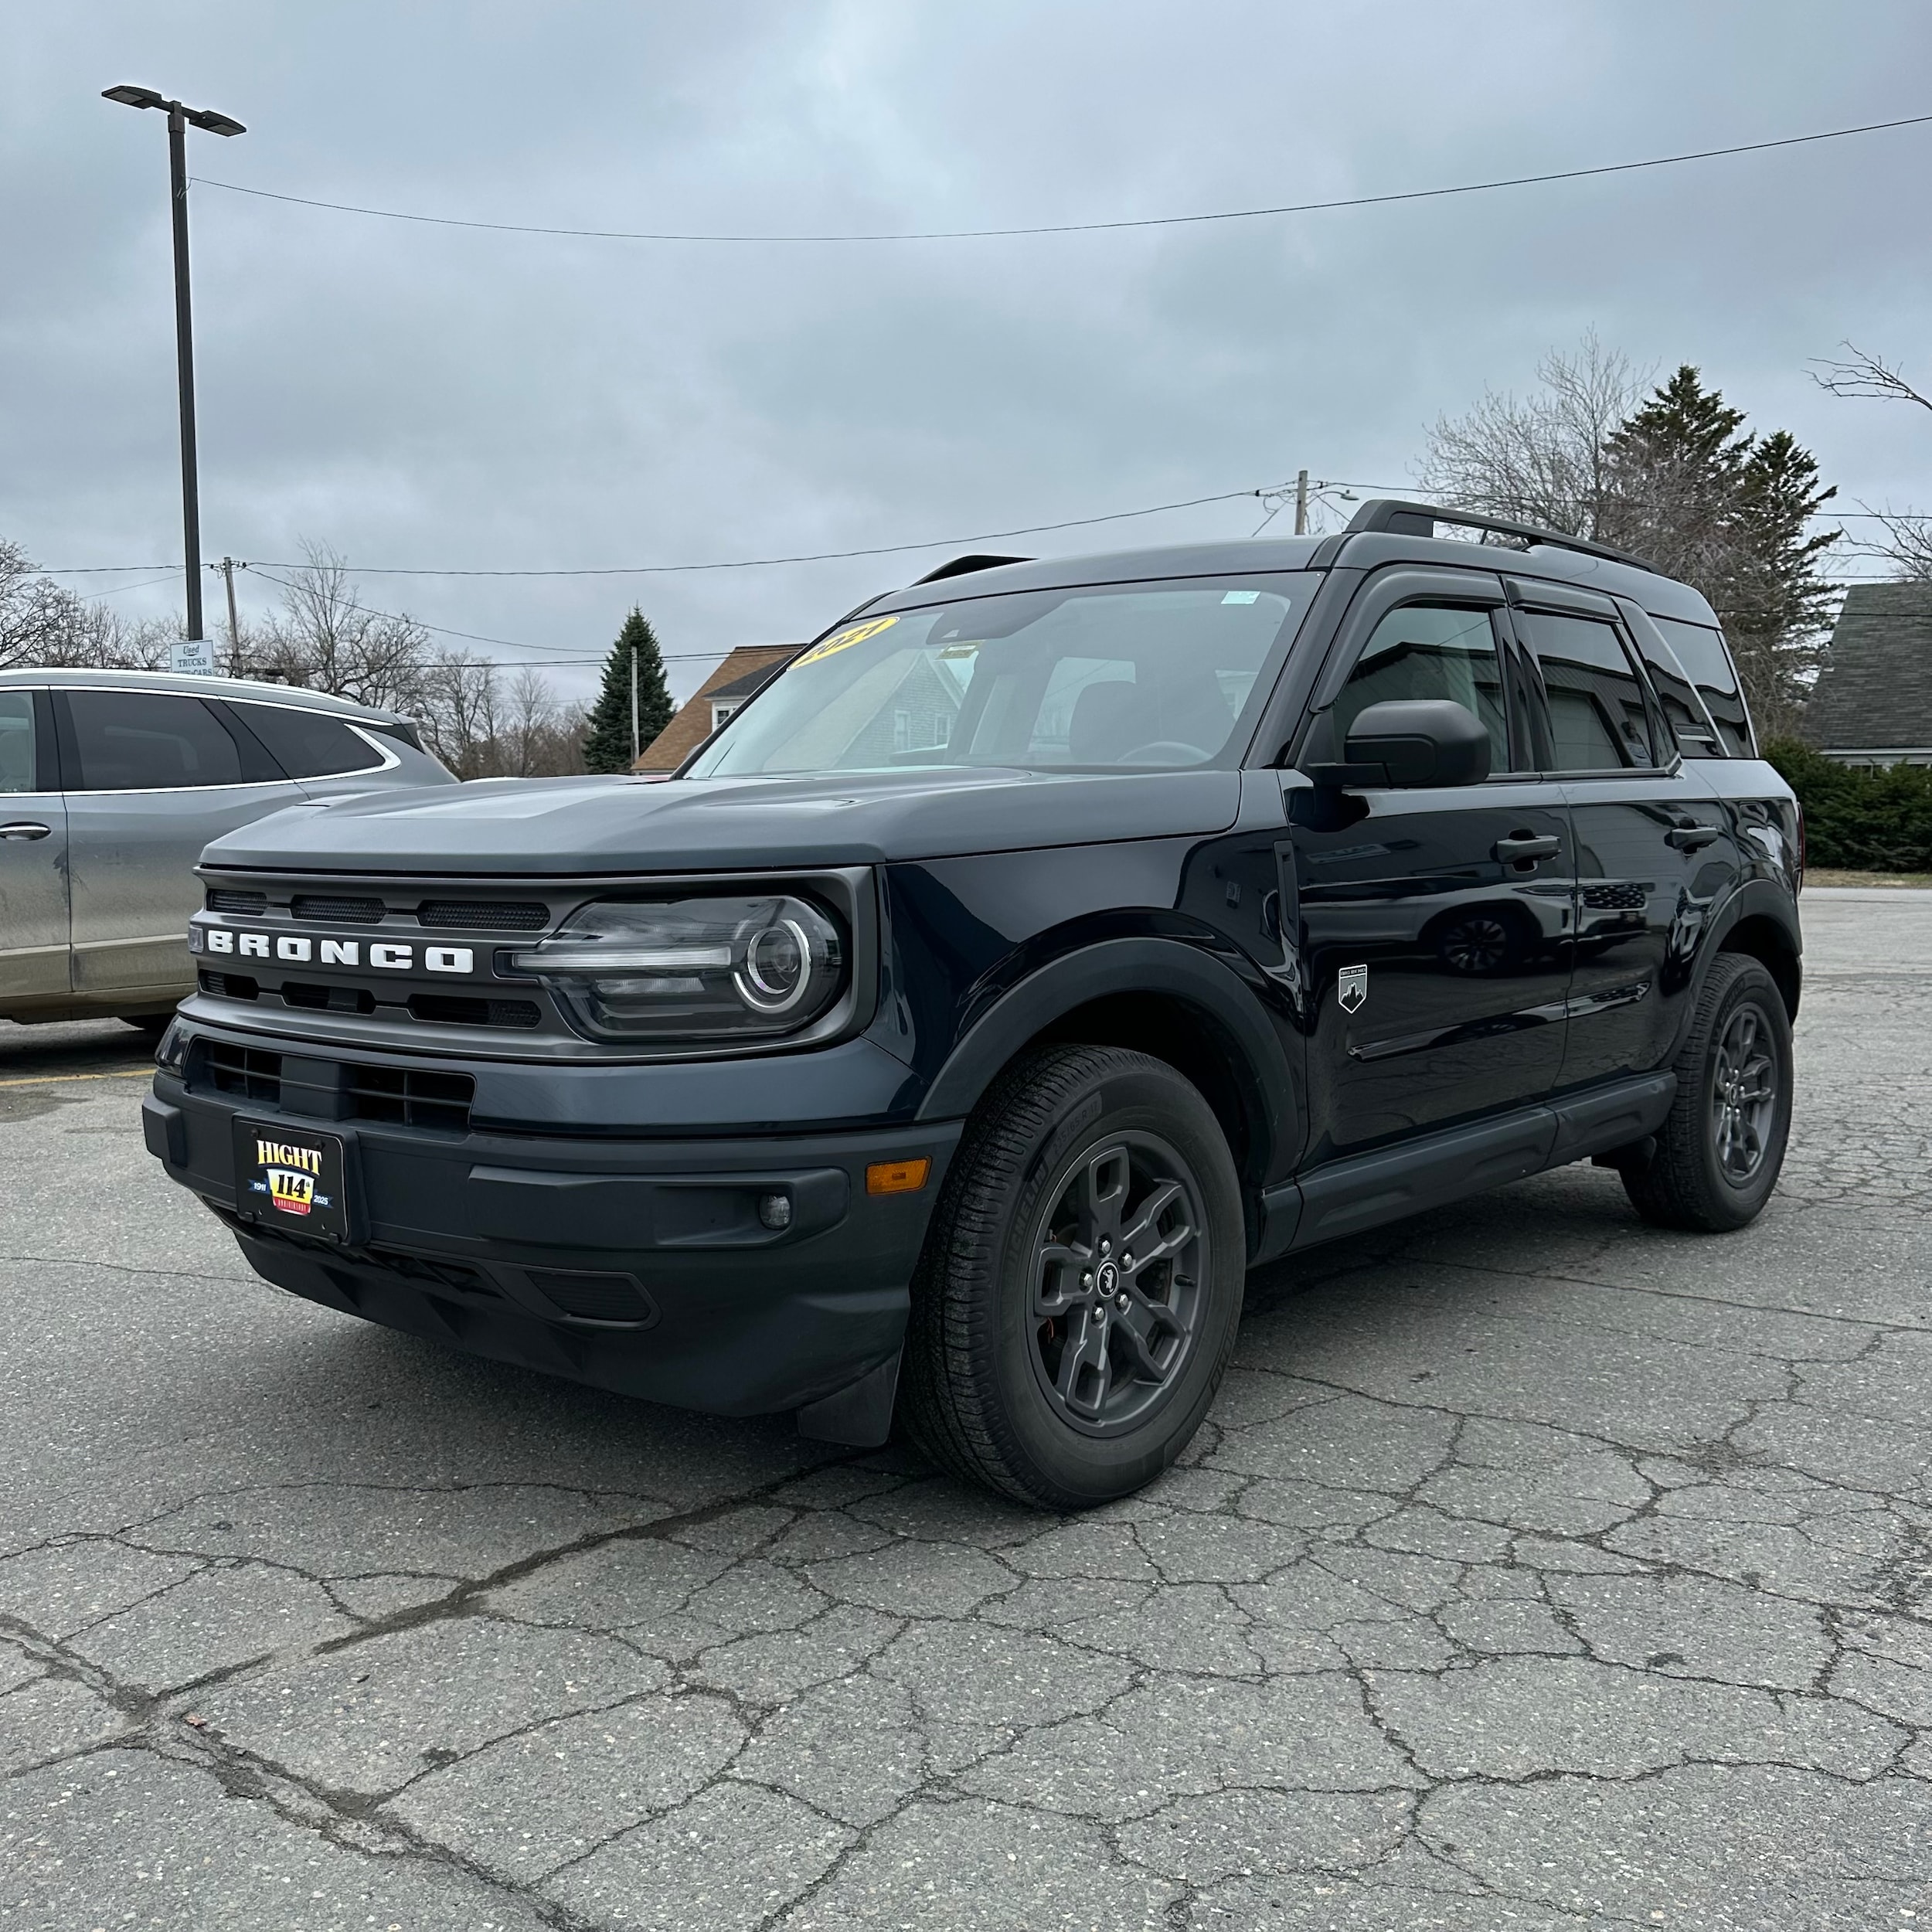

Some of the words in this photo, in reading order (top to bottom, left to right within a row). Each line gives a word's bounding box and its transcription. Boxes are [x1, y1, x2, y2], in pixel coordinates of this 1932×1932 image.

[794, 619, 888, 667] 2021
[183, 645, 199, 654] Used
[178, 657, 207, 667] TRUCKS
[208, 930, 473, 973] BRONCO
[257, 1140, 322, 1175] HIGHT
[253, 1182, 266, 1191] 1911
[314, 1195, 328, 1205] 2025
